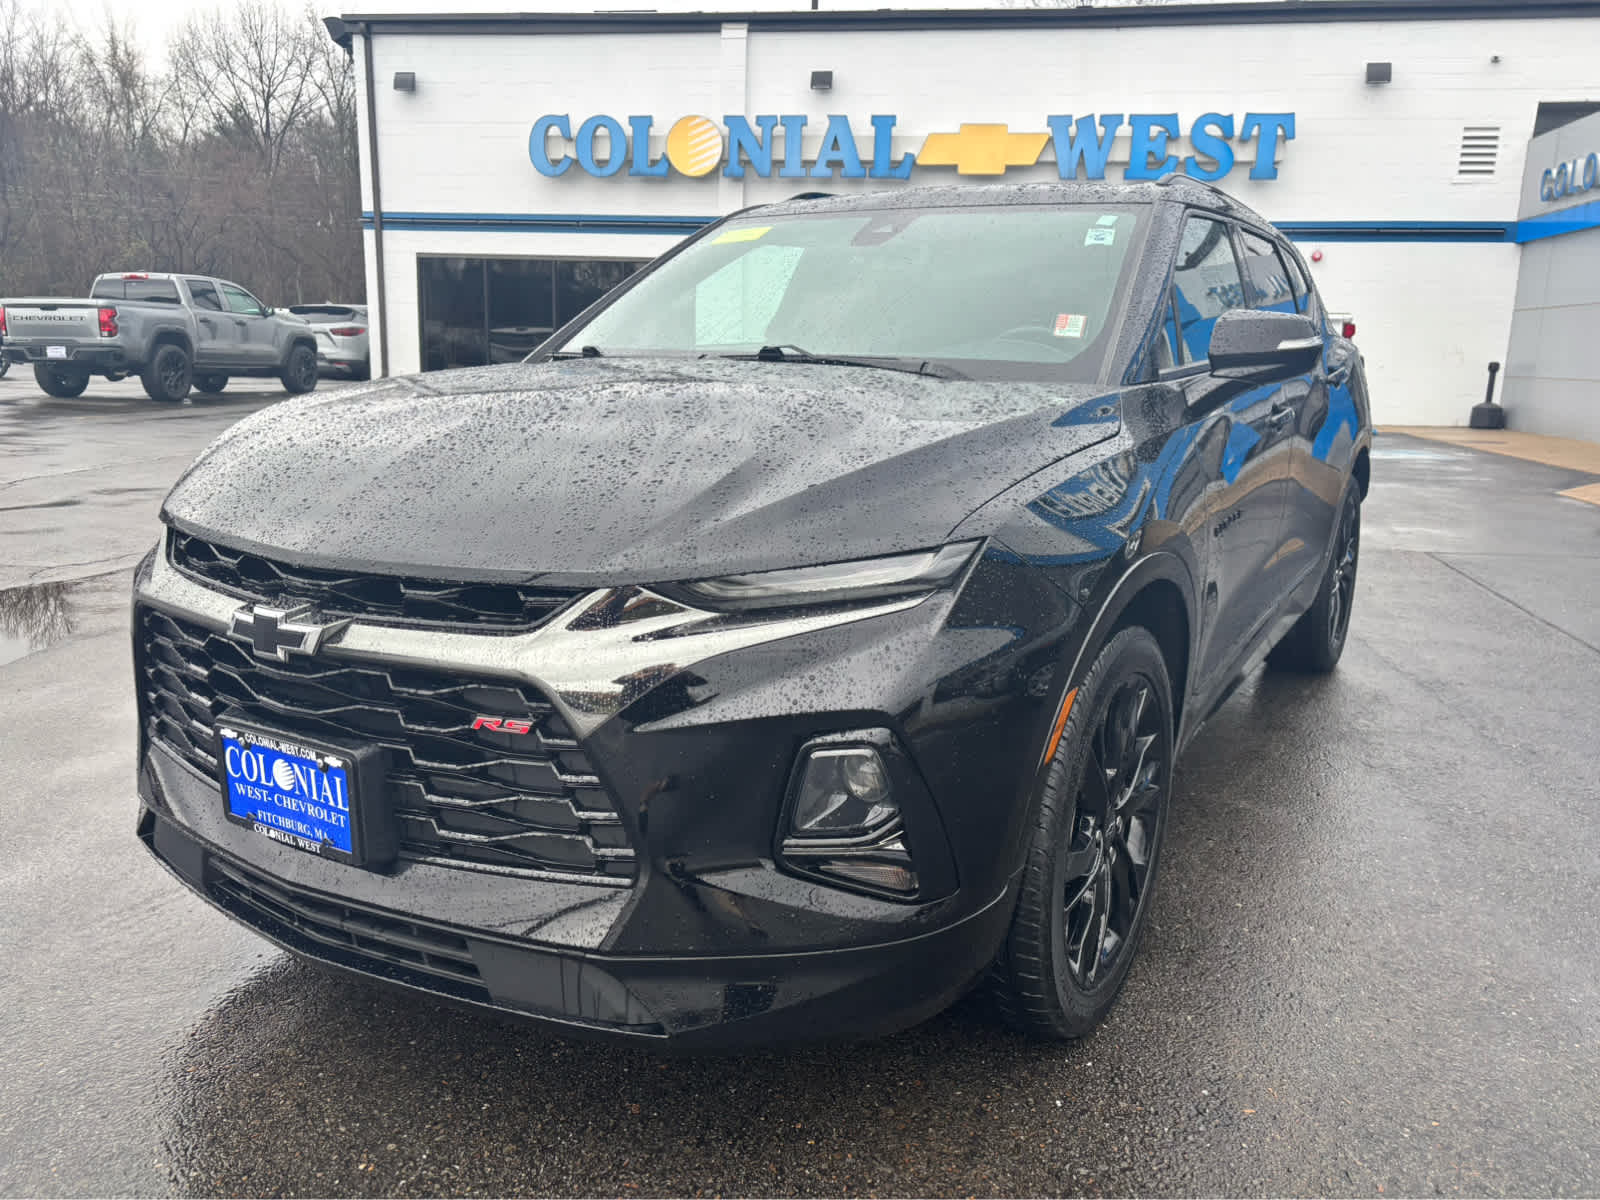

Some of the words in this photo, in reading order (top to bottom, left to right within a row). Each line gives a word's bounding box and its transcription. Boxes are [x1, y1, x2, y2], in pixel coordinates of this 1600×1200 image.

[529, 114, 914, 180] COLONIAL
[1047, 112, 1295, 182] WEST
[12, 313, 87, 321] CHEVROLET
[470, 716, 533, 735] RS
[244, 733, 317, 761] COLONIAL-WEST.COM
[225, 746, 349, 811] COLONIAL
[257, 809, 313, 839] FITCHBURG,
[274, 793, 346, 827] CHEVROLET
[253, 823, 296, 846] COLONIAL
[297, 837, 321, 853] WEST
